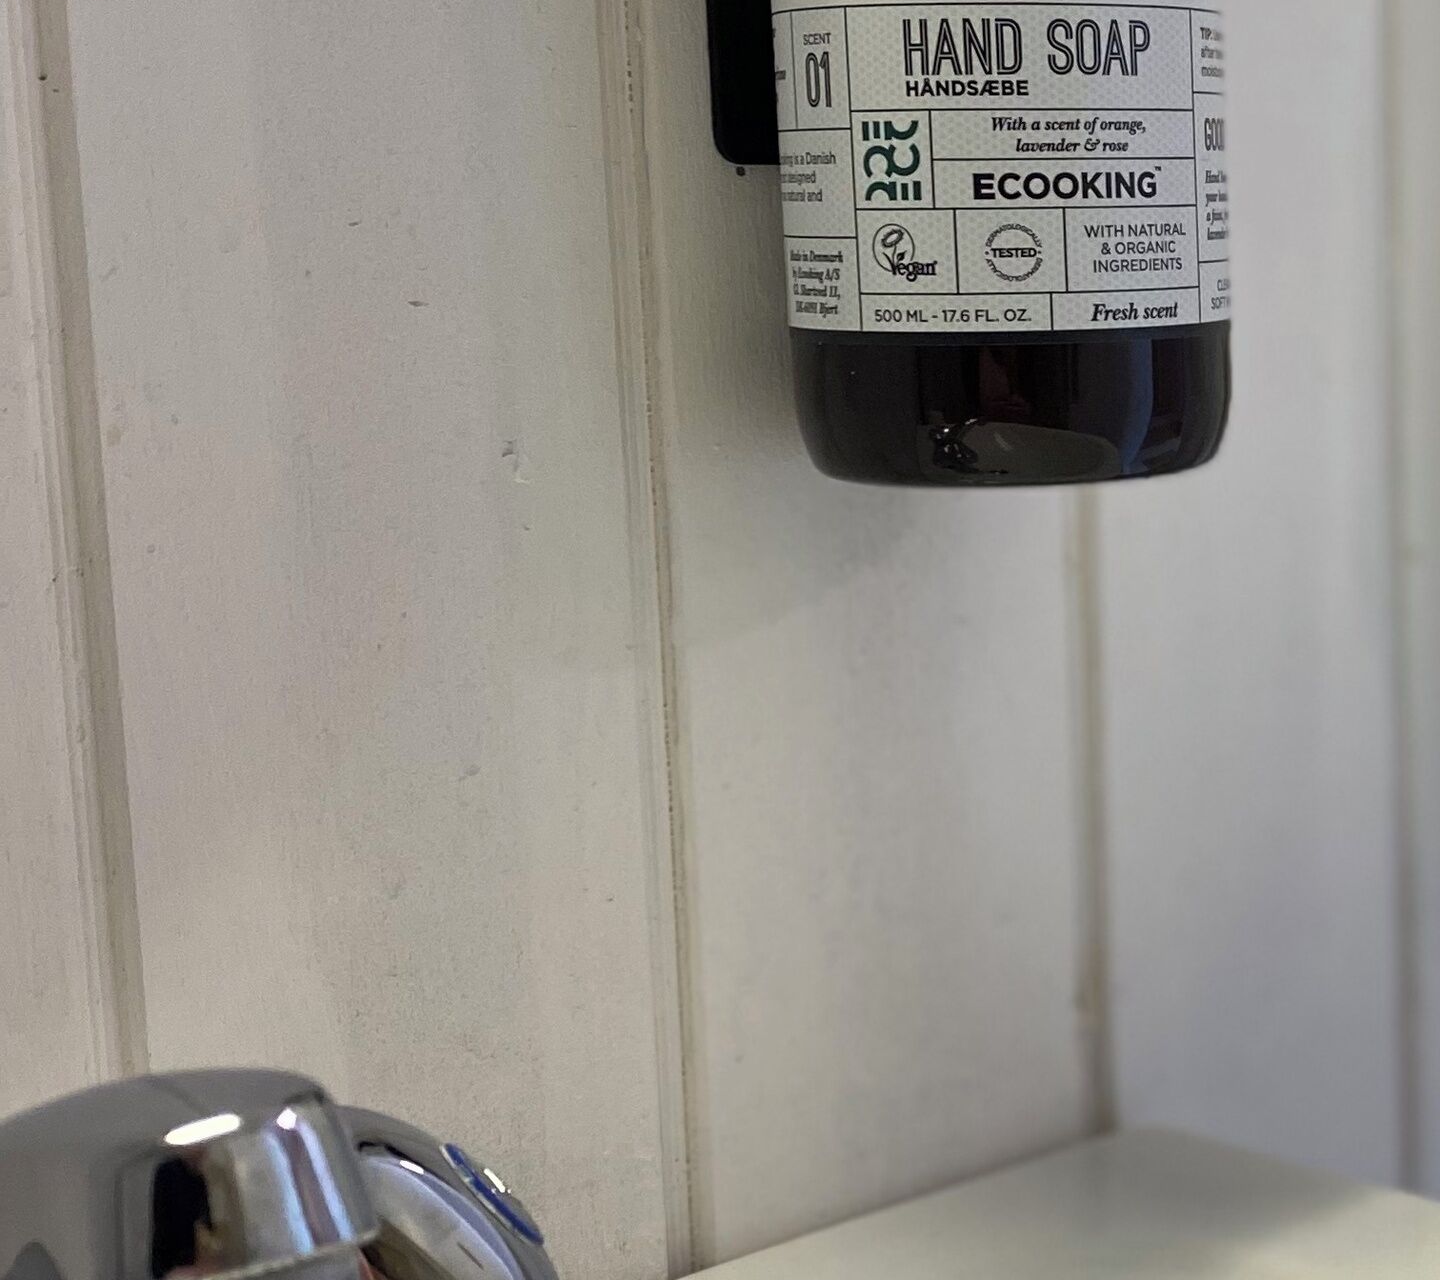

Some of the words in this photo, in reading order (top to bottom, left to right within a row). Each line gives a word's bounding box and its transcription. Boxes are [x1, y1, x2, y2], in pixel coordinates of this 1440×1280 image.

[803, 32, 831, 46] SCENT
[902, 18, 1023, 76] HAND
[1047, 19, 1151, 76] SOAP
[805, 51, 832, 108] 01
[905, 79, 1029, 97] HÅNDSÆBE
[991, 117, 1027, 131] With
[1031, 120, 1041, 131] a
[1044, 118, 1080, 131] scent
[1083, 117, 1101, 135] of
[1100, 120, 1146, 136] orange,
[1016, 138, 1080, 152] lavender
[1084, 138, 1101, 152] &
[1102, 141, 1128, 152] rose
[1084, 224, 1124, 238] WITH
[1127, 223, 1187, 238] NATURAL
[990, 247, 1037, 258] TESTED
[1101, 242, 1112, 255] &
[1114, 240, 1176, 255] ORGANIC
[1093, 257, 1183, 273] INGREDIENTS
[874, 309, 902, 322] 500
[906, 309, 928, 322] ML
[941, 309, 970, 322] 17.6
[975, 308, 1000, 322] FL.
[1003, 308, 1032, 322] OZ.
[1091, 302, 1139, 322] Fresh
[1142, 302, 1178, 319] scent
